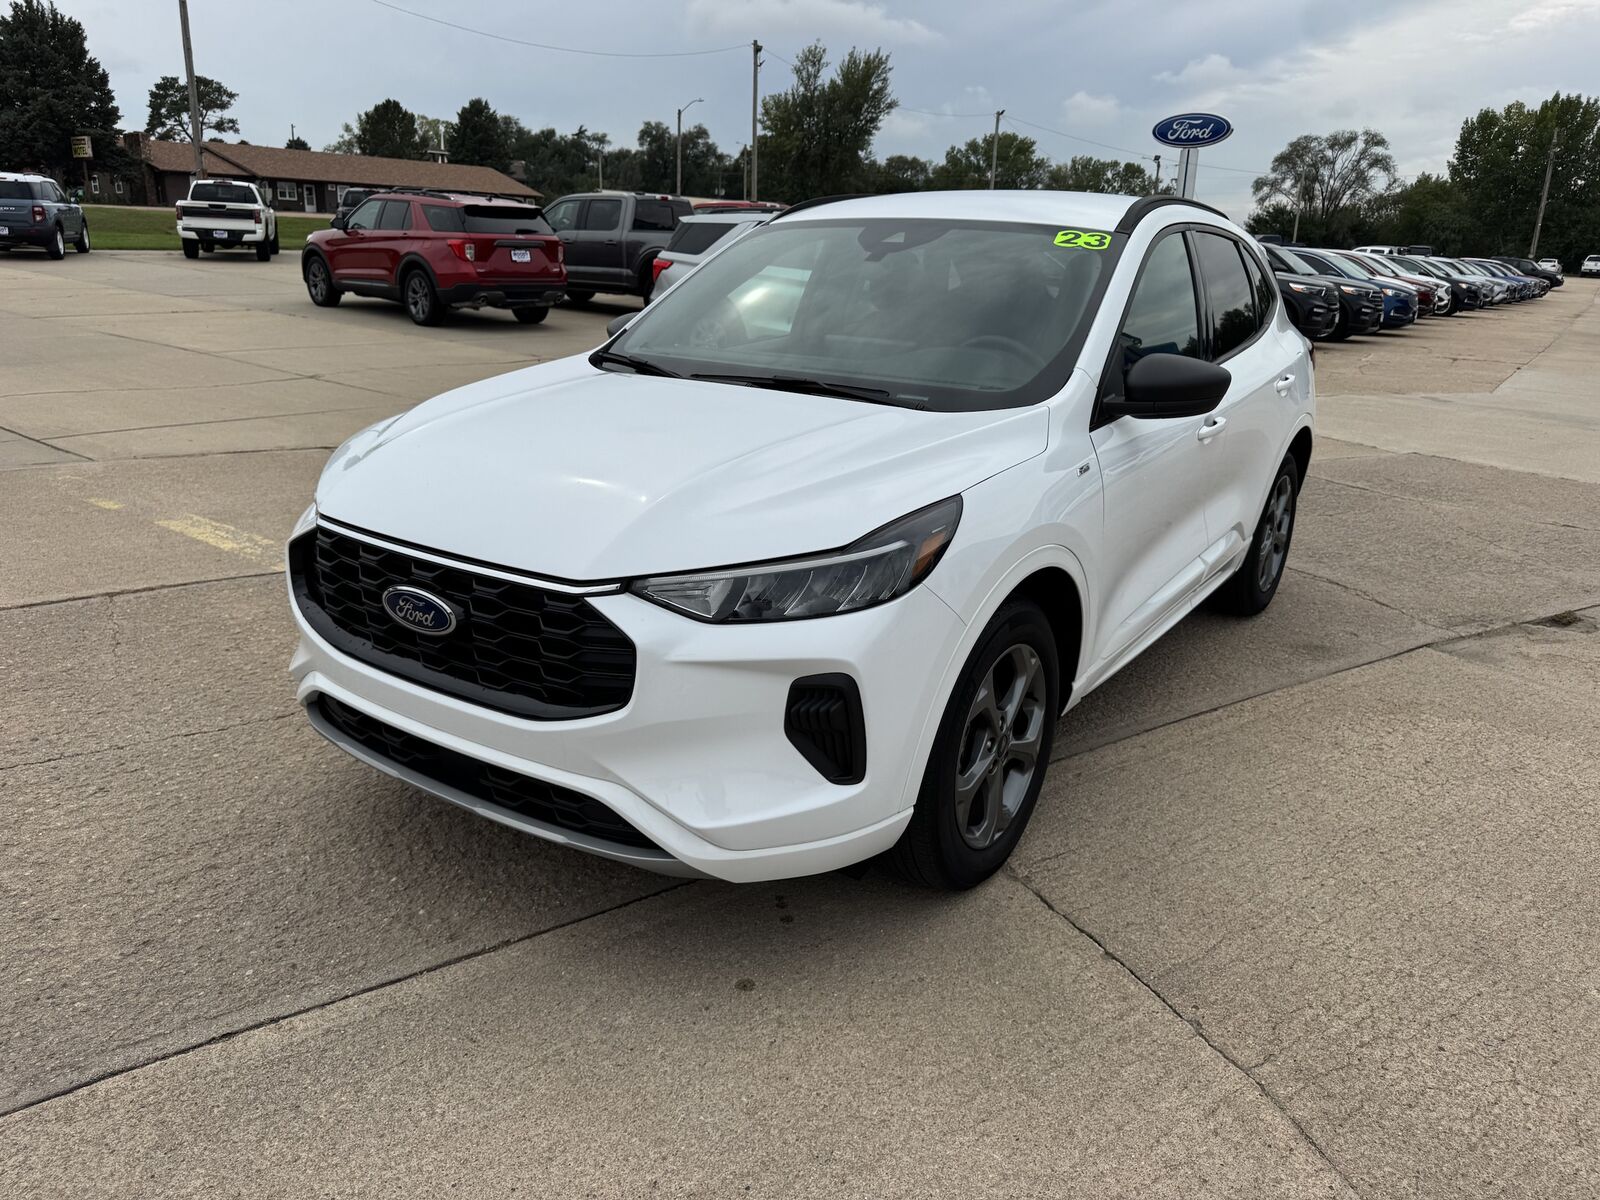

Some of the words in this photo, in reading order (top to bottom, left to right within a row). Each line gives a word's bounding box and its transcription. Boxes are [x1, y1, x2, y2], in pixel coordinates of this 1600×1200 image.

[1167, 119, 1214, 140] Ford
[1055, 230, 1109, 248] 23
[395, 595, 435, 627] Ford
